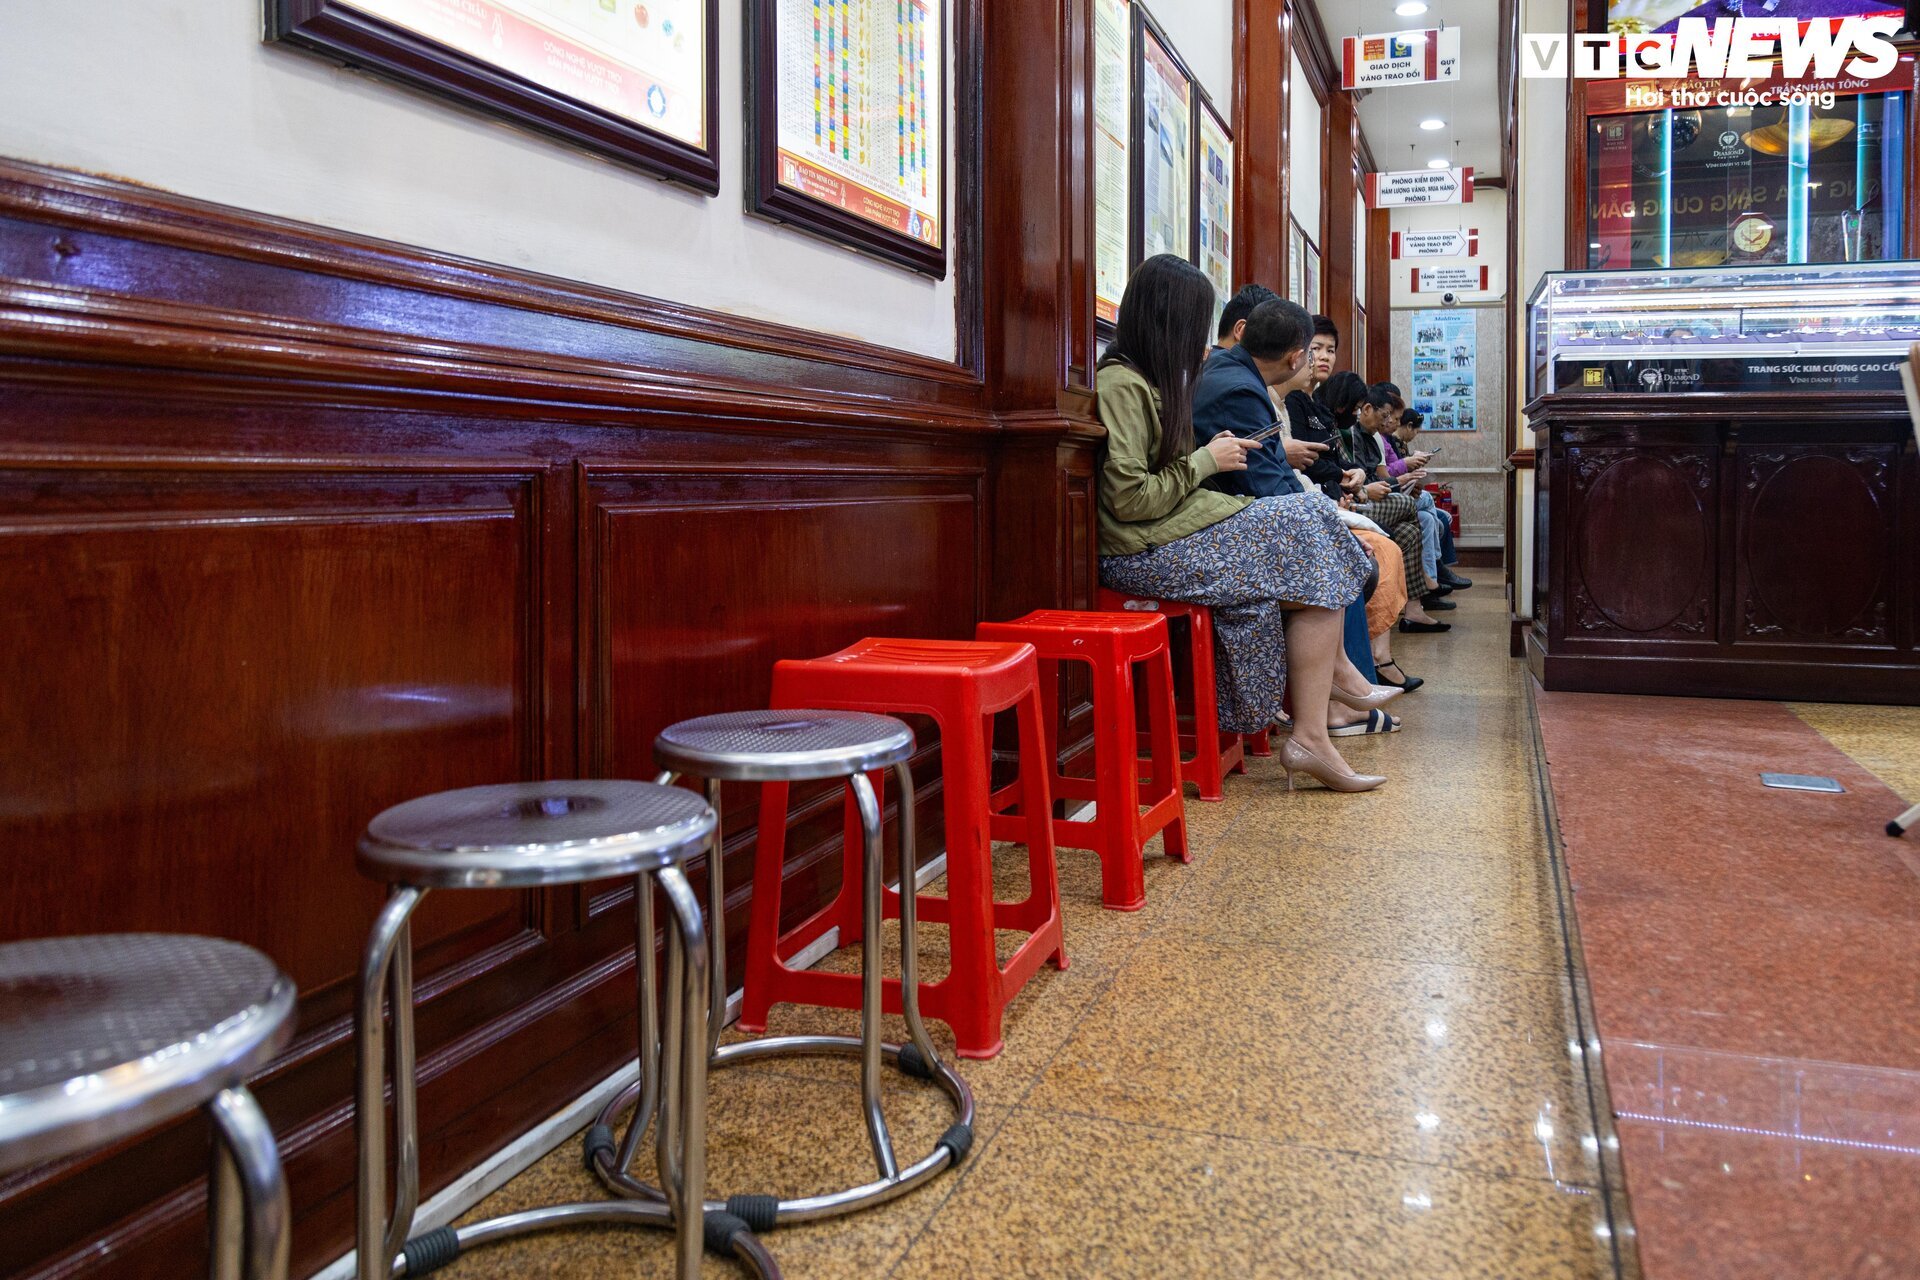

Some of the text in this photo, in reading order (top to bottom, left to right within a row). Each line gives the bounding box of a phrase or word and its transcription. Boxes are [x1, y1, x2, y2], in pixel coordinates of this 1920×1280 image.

[1392, 62, 1411, 70] DỊCH
[1360, 68, 1420, 82] VÀNG TRAO ĐỔI
[1444, 67, 1451, 76] 4
[1802, 80, 1835, 92] NHÂN
[1839, 79, 1870, 89] TÔNG
[1747, 365, 1780, 373] TRANG
[1782, 364, 1801, 373] SỨC
[1822, 364, 1858, 372] CƯƠNG
[1859, 364, 1881, 372] CAO
[1663, 373, 1700, 381] DIAMOND
